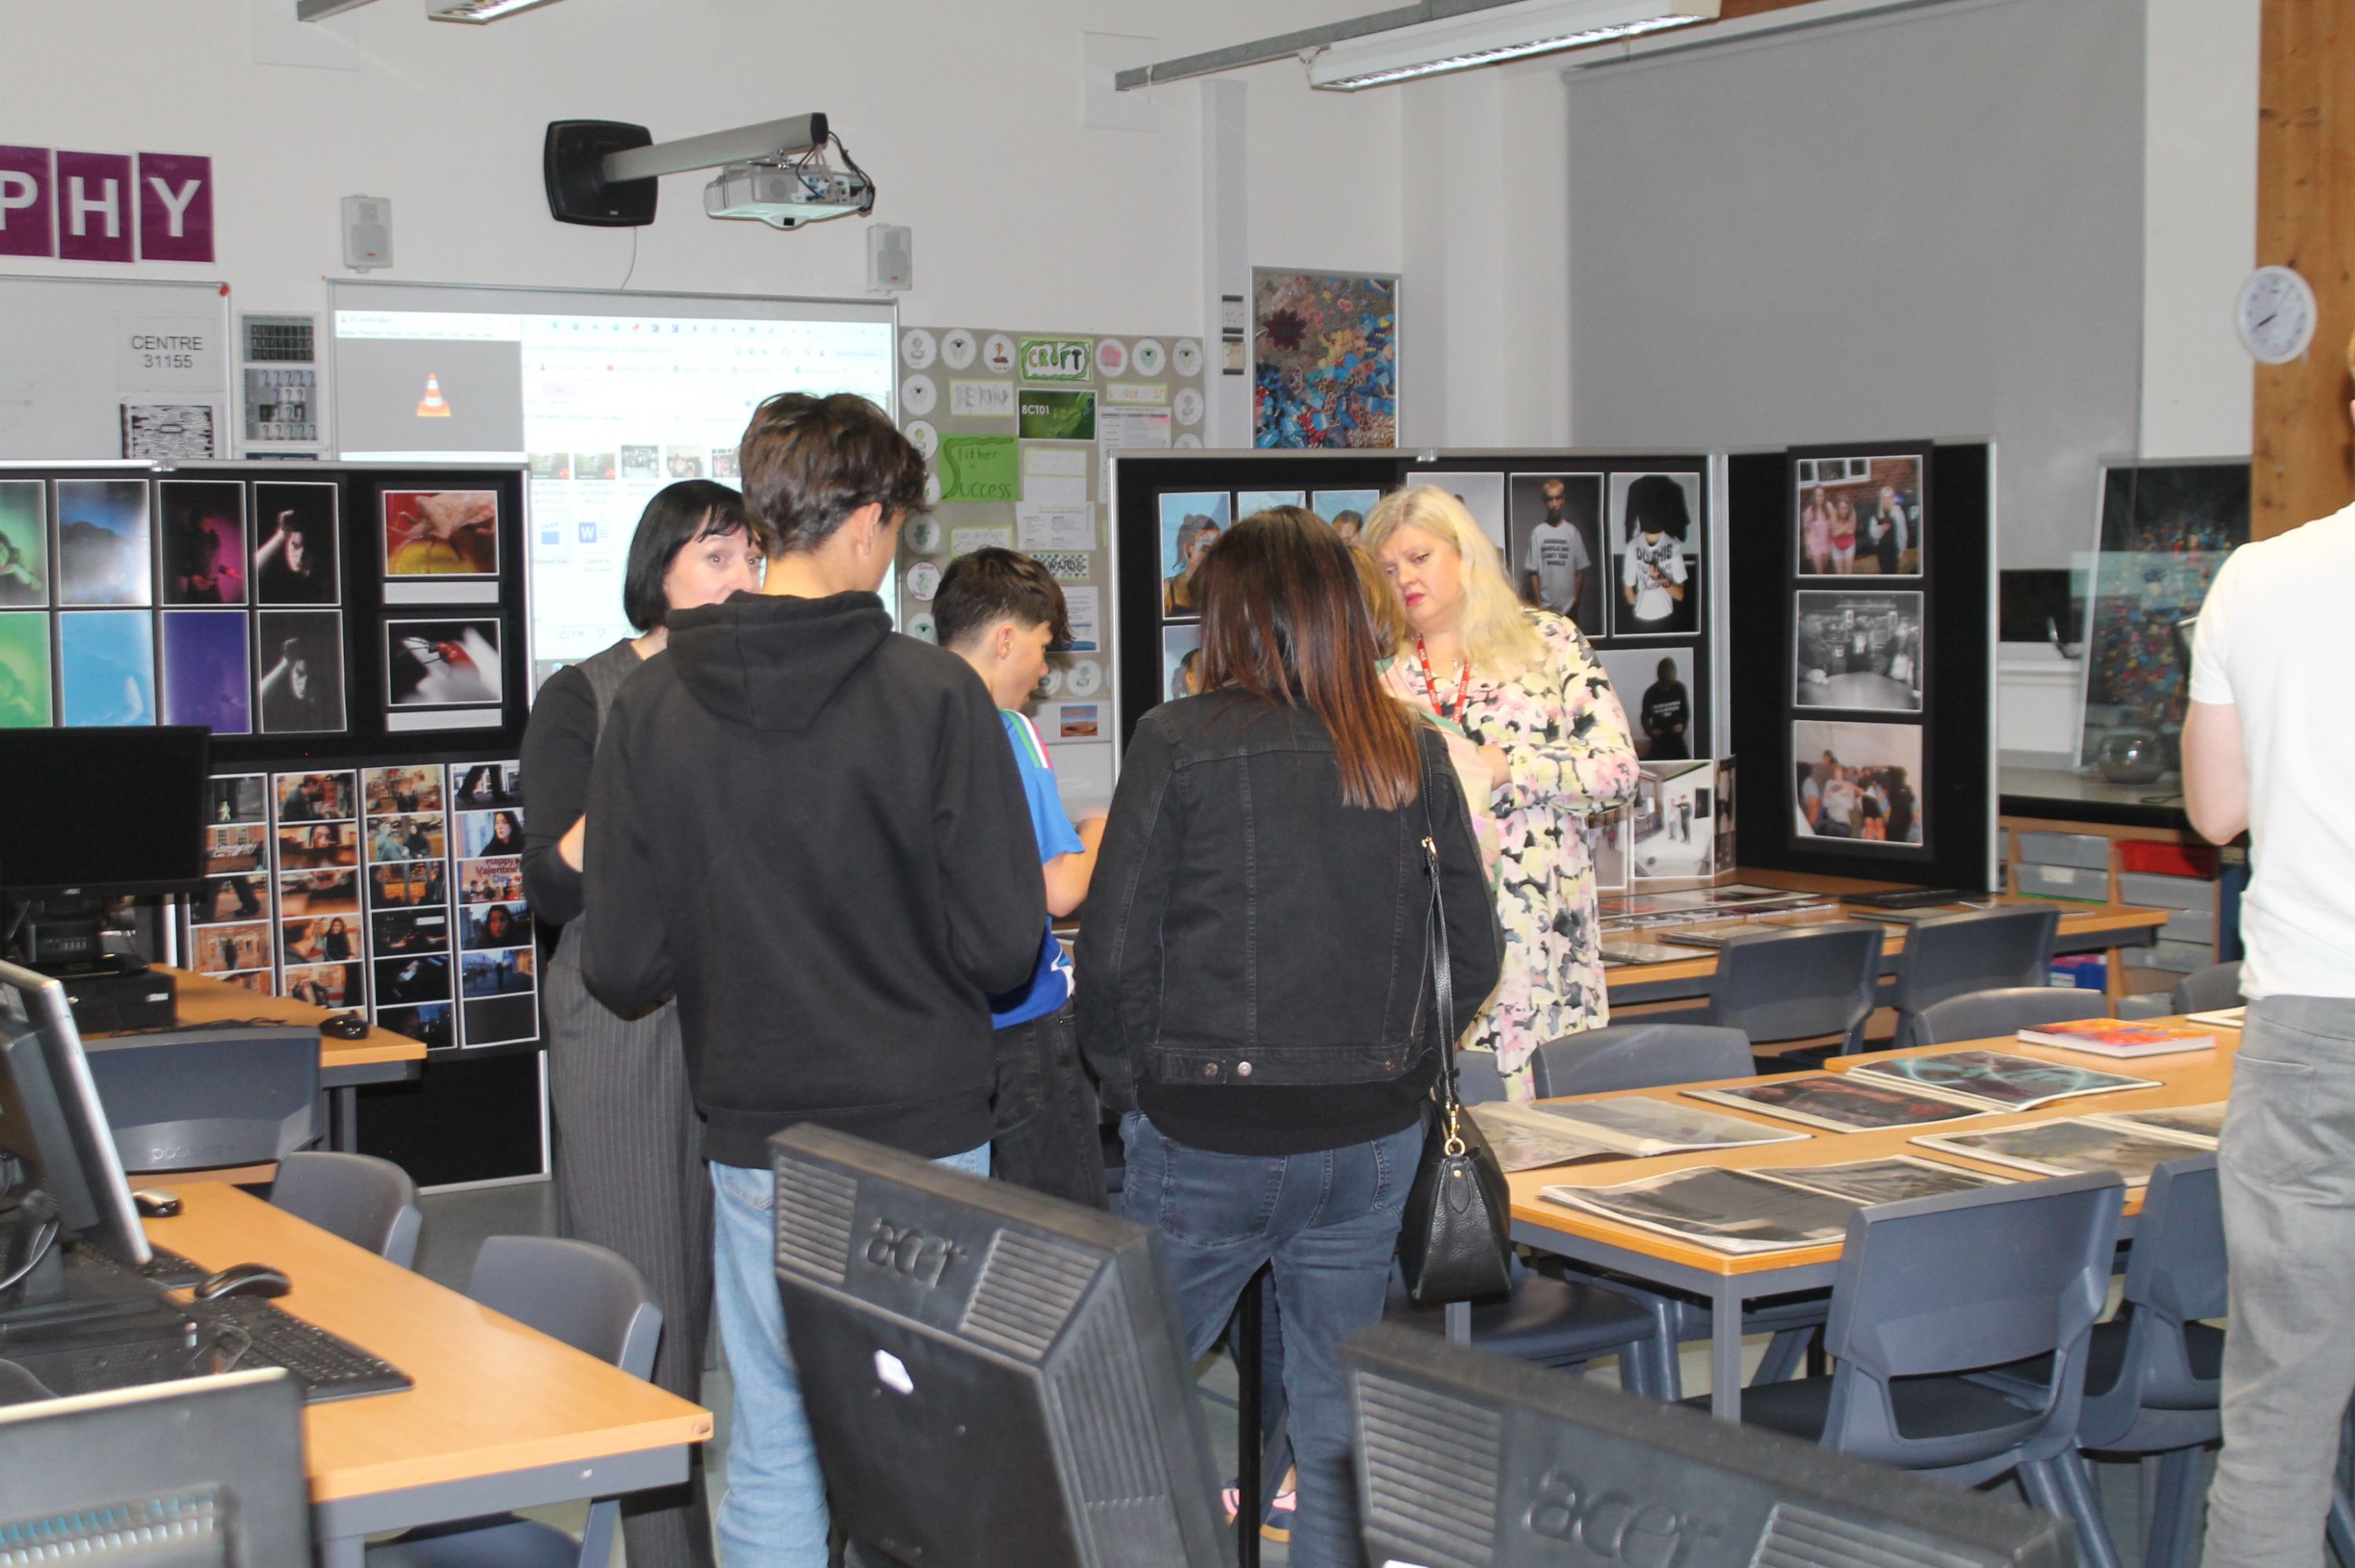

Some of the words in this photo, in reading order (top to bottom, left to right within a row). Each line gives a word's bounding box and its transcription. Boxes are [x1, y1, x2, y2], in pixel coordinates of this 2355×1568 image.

[0, 170, 202, 238] PHY
[131, 335, 204, 351] CENTRE
[143, 354, 194, 369] 31155
[859, 1216, 969, 1289] acer
[1520, 1467, 1724, 1568] acer
